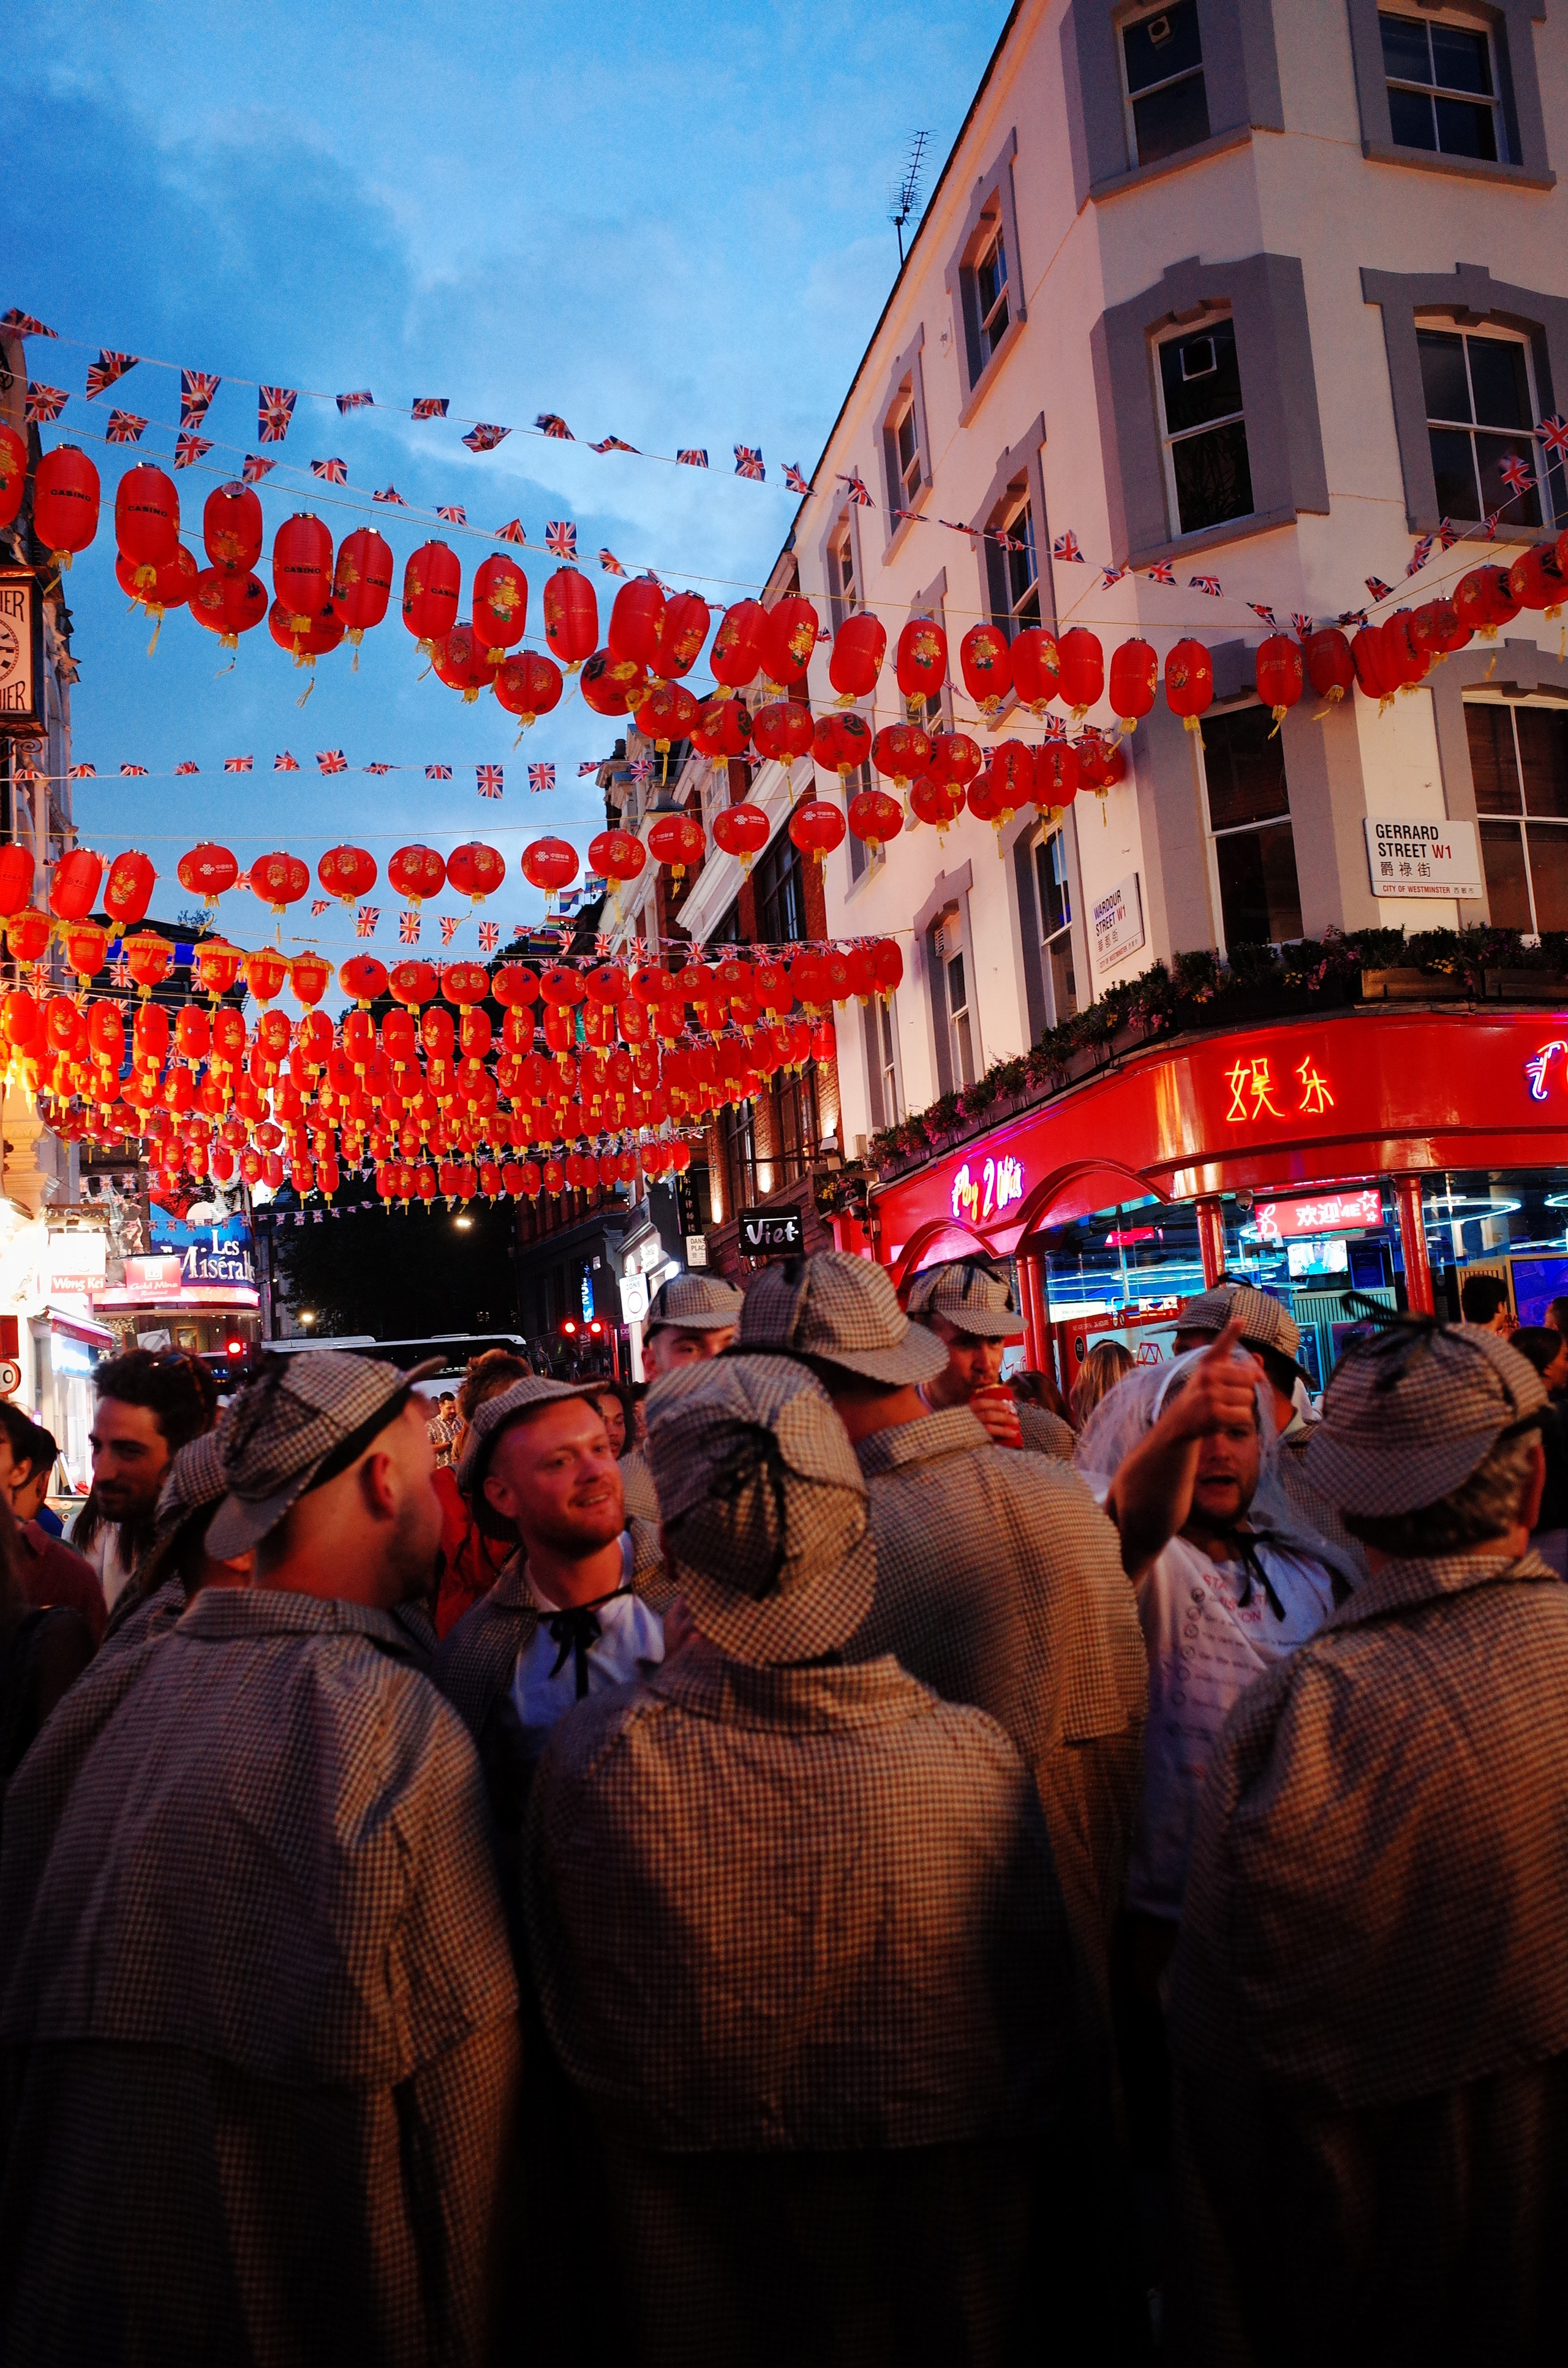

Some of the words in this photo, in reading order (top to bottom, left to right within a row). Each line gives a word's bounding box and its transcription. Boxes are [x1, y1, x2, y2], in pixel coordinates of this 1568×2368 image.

[50, 490, 91, 502] CASINO
[128, 505, 167, 518] CASINO
[284, 566, 321, 574] CASINO
[1376, 824, 1439, 840] GERRARD
[1378, 842, 1427, 858] STREET
[1431, 844, 1452, 859] W1
[1094, 890, 1121, 920] WARDOUR
[1096, 912, 1115, 937] STREET
[1117, 904, 1126, 921] W1
[982, 1158, 995, 1217] 2
[1295, 1203, 1340, 1227] 欢迎
[746, 1219, 796, 1245] Viet
[211, 1229, 239, 1255] Les
[53, 1277, 85, 1292] Wong
[87, 1277, 104, 1289] Kei
[154, 1280, 178, 1290] Mine
[626, 1281, 641, 1290] ZONE
[0, 1369, 13, 1384] 0
